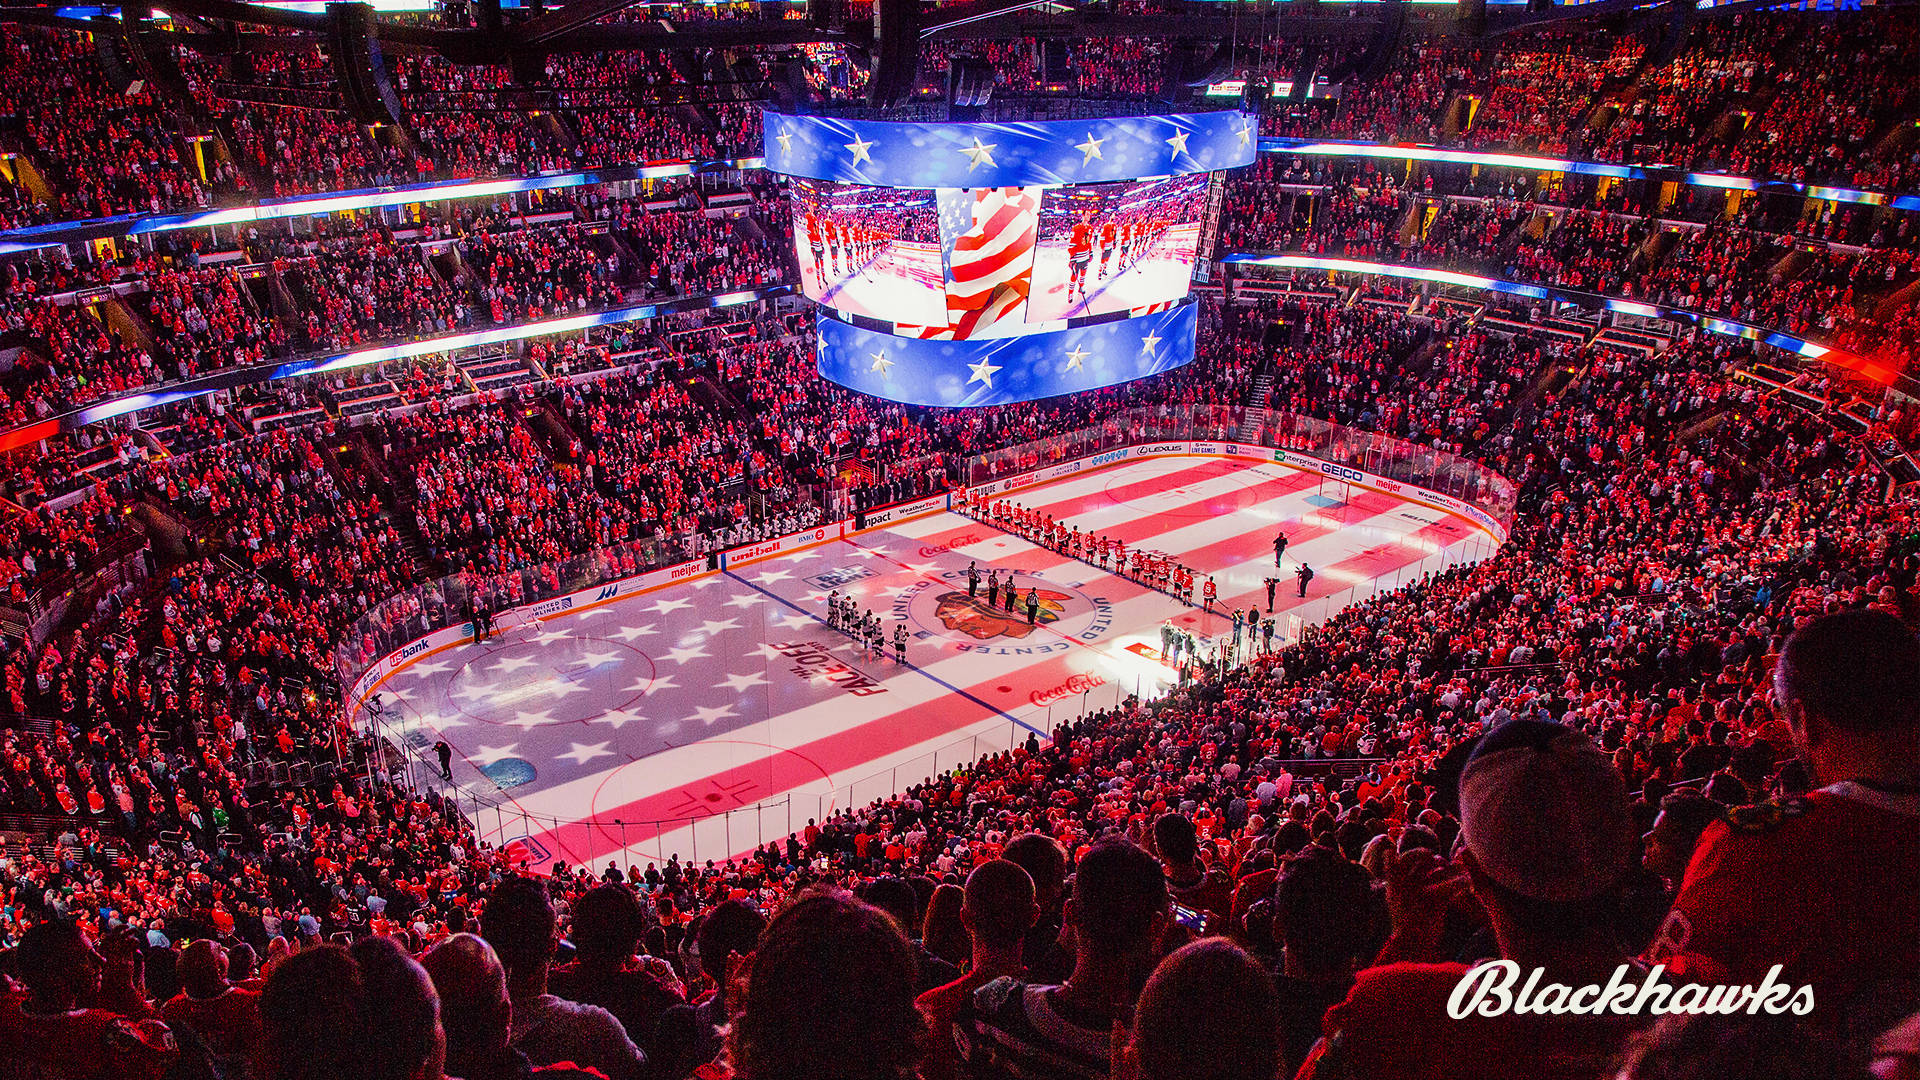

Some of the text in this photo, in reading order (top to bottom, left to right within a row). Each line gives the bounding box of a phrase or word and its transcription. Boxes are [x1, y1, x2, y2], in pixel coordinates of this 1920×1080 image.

[1148, 445, 1182, 453] LEXUS
[1321, 463, 1363, 482] GEICO
[1375, 479, 1402, 493] meijer
[898, 499, 941, 514] WeatherTech
[671, 563, 701, 579] meijer
[532, 601, 560, 612] UNITED
[892, 580, 931, 621] UNITED
[1082, 597, 1113, 640] UNITED
[957, 642, 1070, 655] CENTER
[1029, 671, 1107, 707] Coca-Cola
